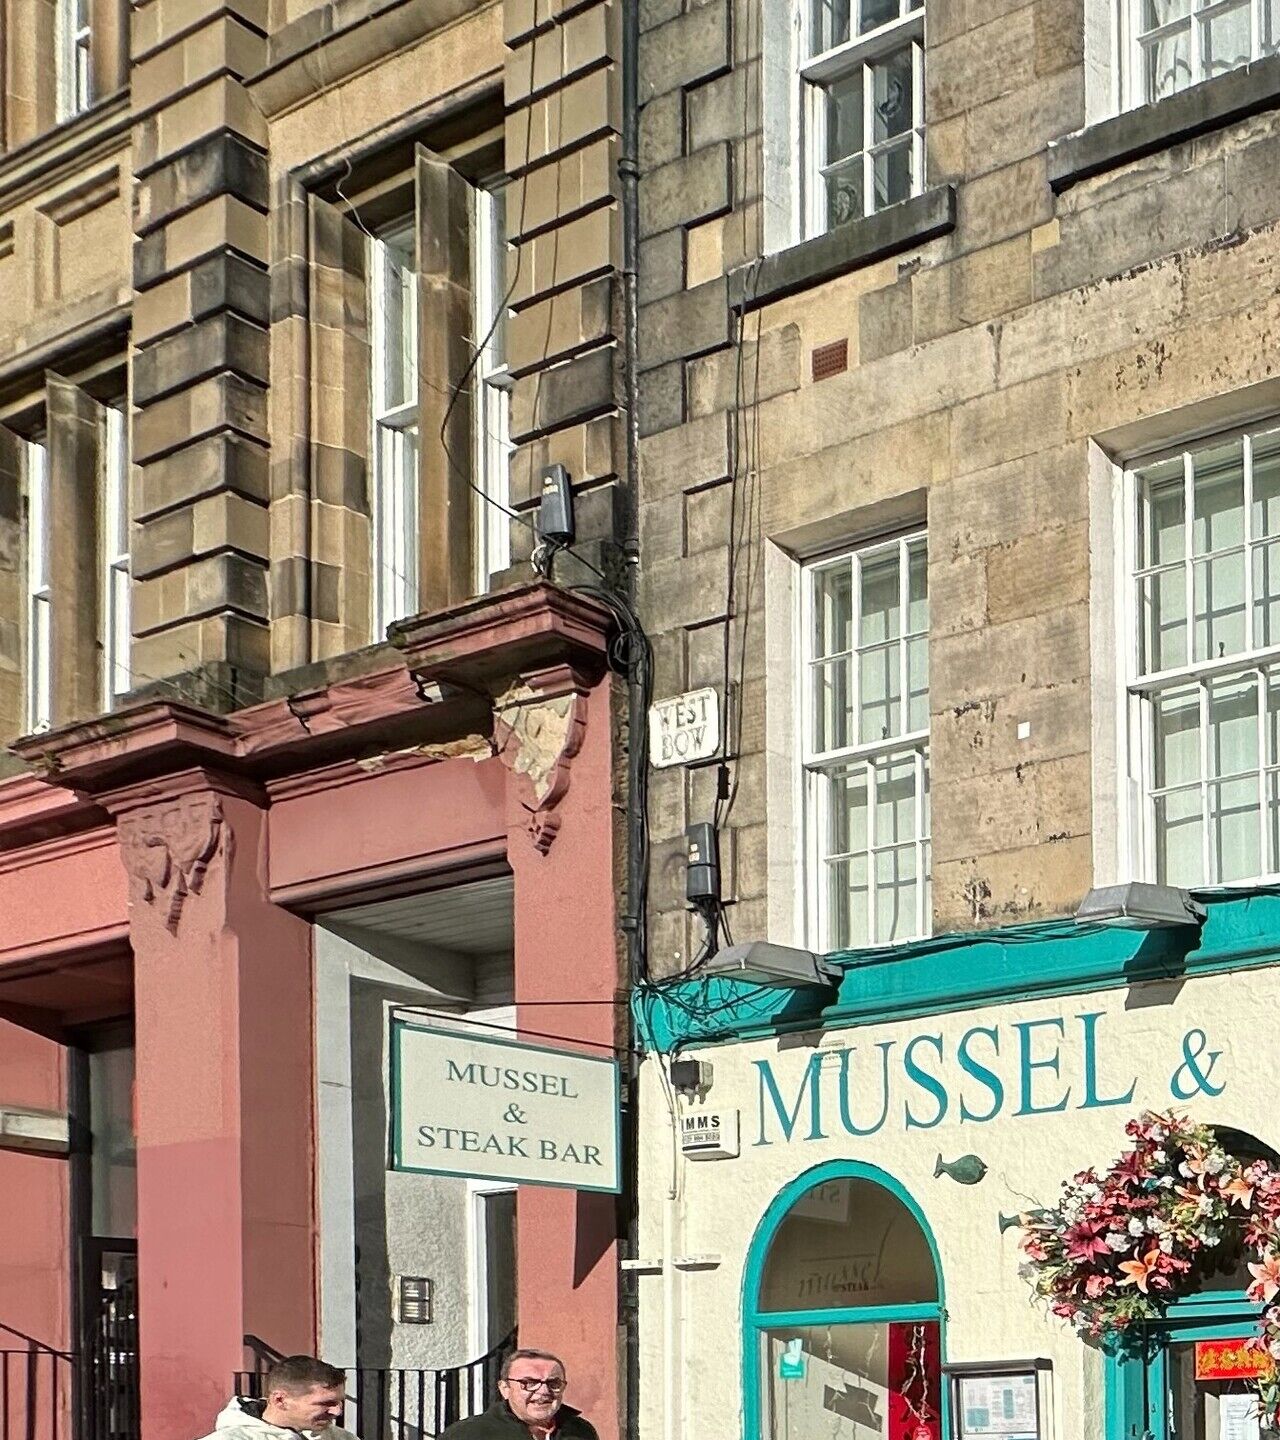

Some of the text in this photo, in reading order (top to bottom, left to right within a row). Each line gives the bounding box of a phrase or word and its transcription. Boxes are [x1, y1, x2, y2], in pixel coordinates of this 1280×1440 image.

[656, 694, 710, 731] WEST
[661, 725, 708, 760] BOW
[446, 1059, 579, 1099] MUSSEL
[750, 1011, 1139, 1147] MUSSEL
[1169, 1027, 1228, 1100] &
[503, 1102, 528, 1125] &
[417, 1125, 604, 1167] STEAK BAR
